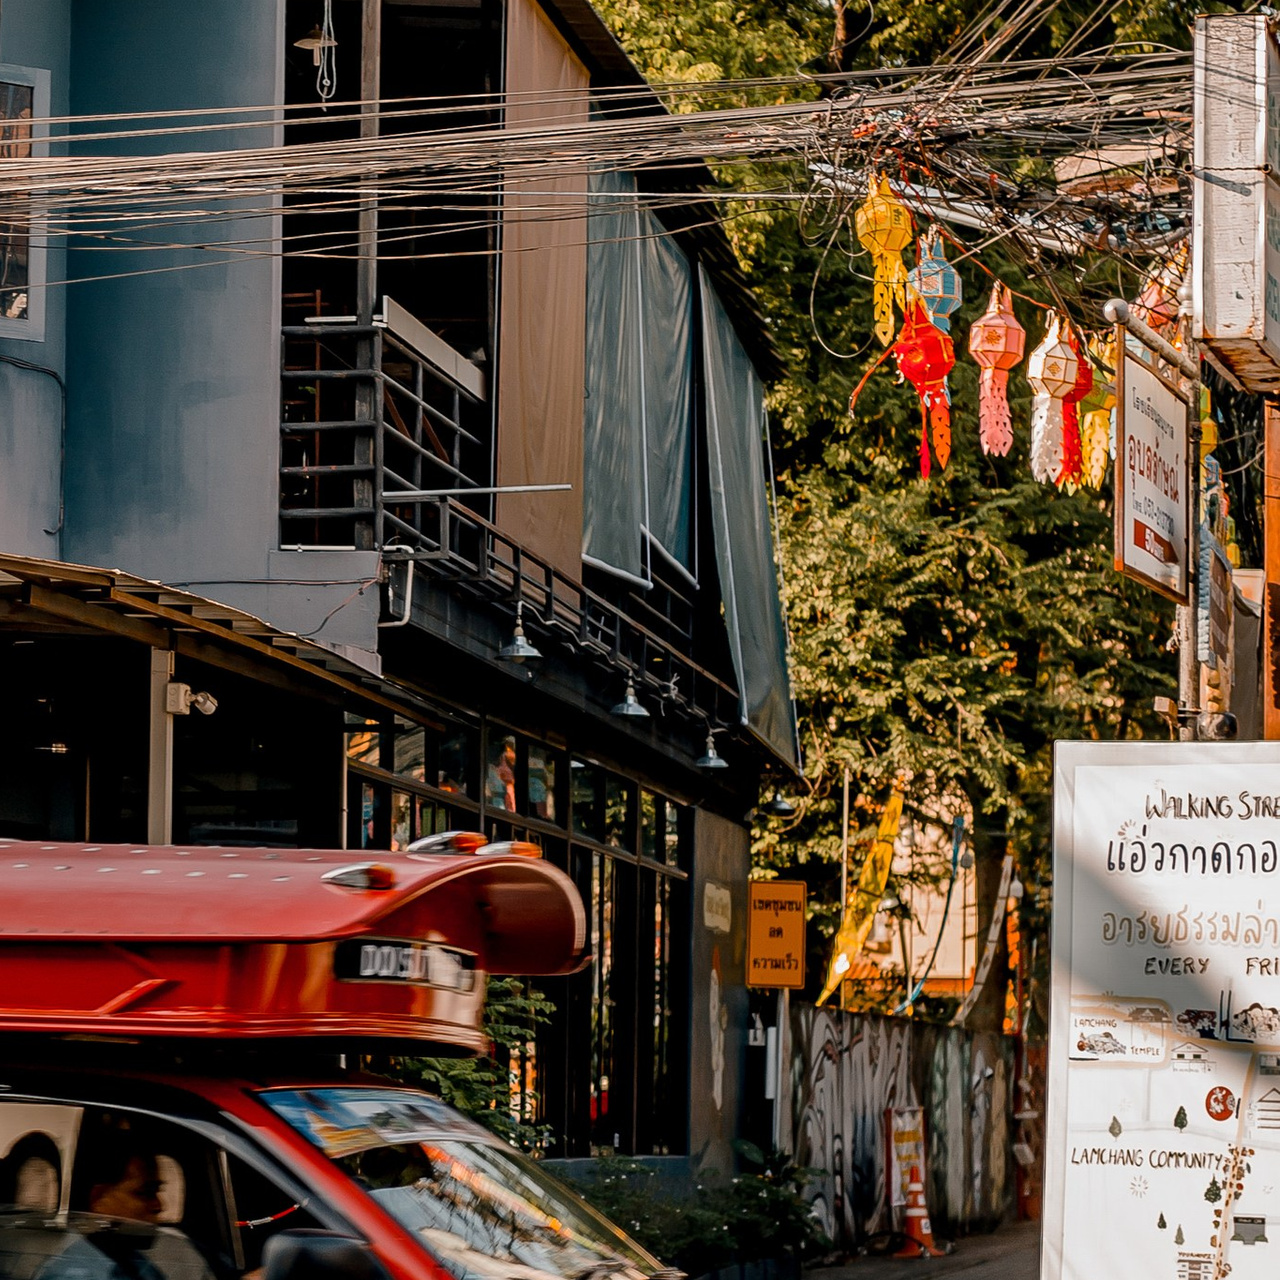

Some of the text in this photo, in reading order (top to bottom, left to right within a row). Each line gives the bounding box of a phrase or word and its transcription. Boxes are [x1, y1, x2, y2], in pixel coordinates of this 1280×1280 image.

[768, 926, 784, 938] ลด
[752, 952, 799, 970] ความเร็ว
[1144, 956, 1210, 976] EVERY
[1071, 1147, 1144, 1167] LAMCHANG
